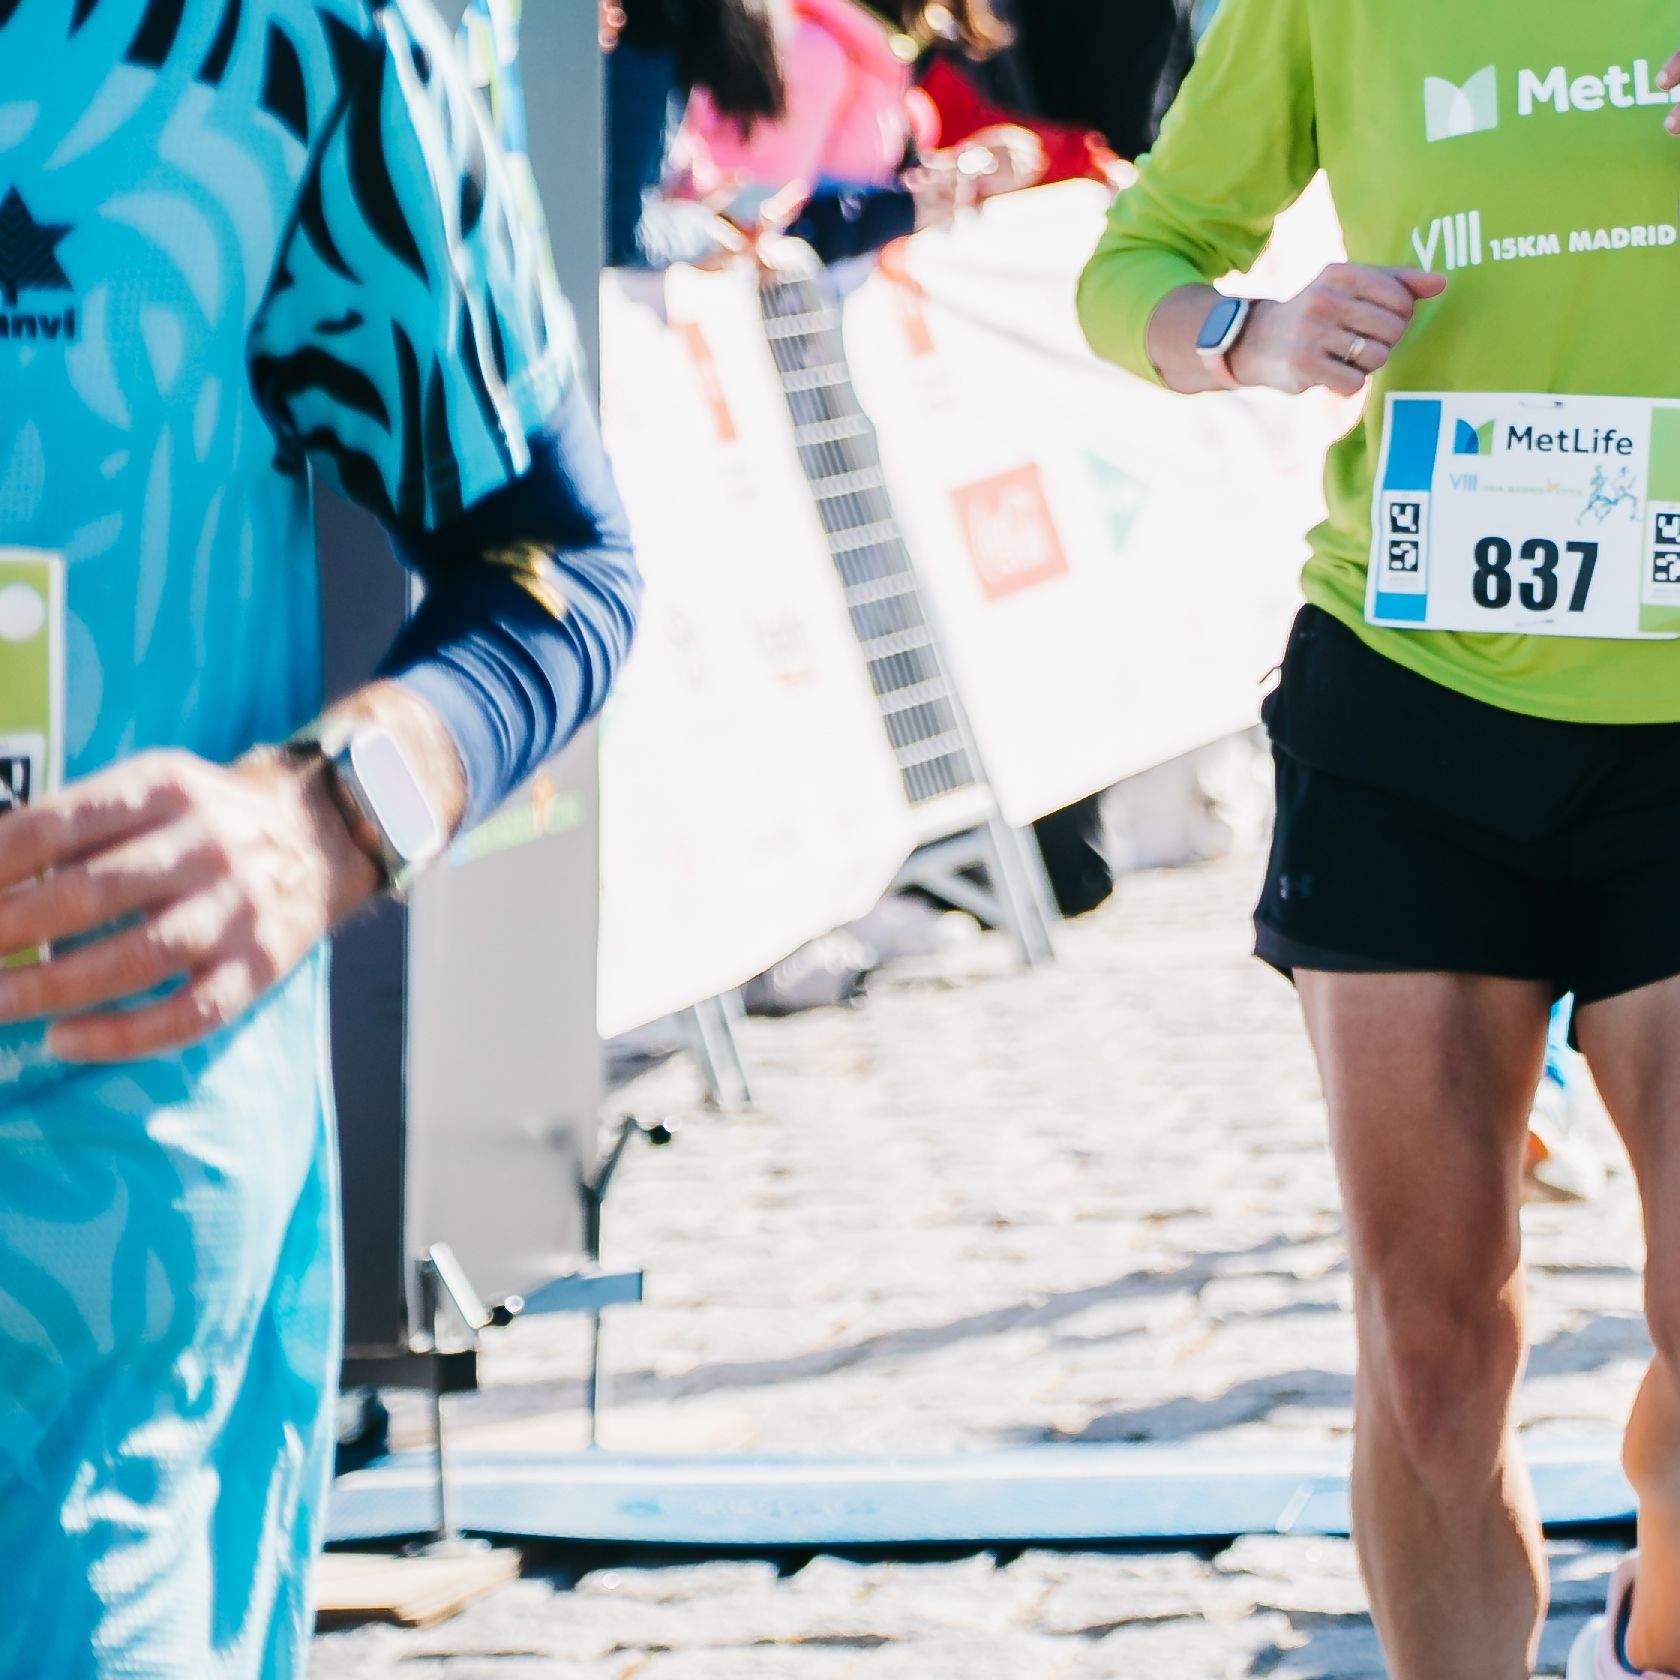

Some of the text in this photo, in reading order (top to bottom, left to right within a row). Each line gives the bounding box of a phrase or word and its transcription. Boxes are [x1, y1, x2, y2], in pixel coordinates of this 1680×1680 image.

[1411, 209, 1482, 273] VIII
[1489, 234, 1561, 261] 15KM
[1568, 224, 1677, 252] MADRID
[1504, 425, 1634, 456] MetLife
[1472, 536, 1599, 613] 837
